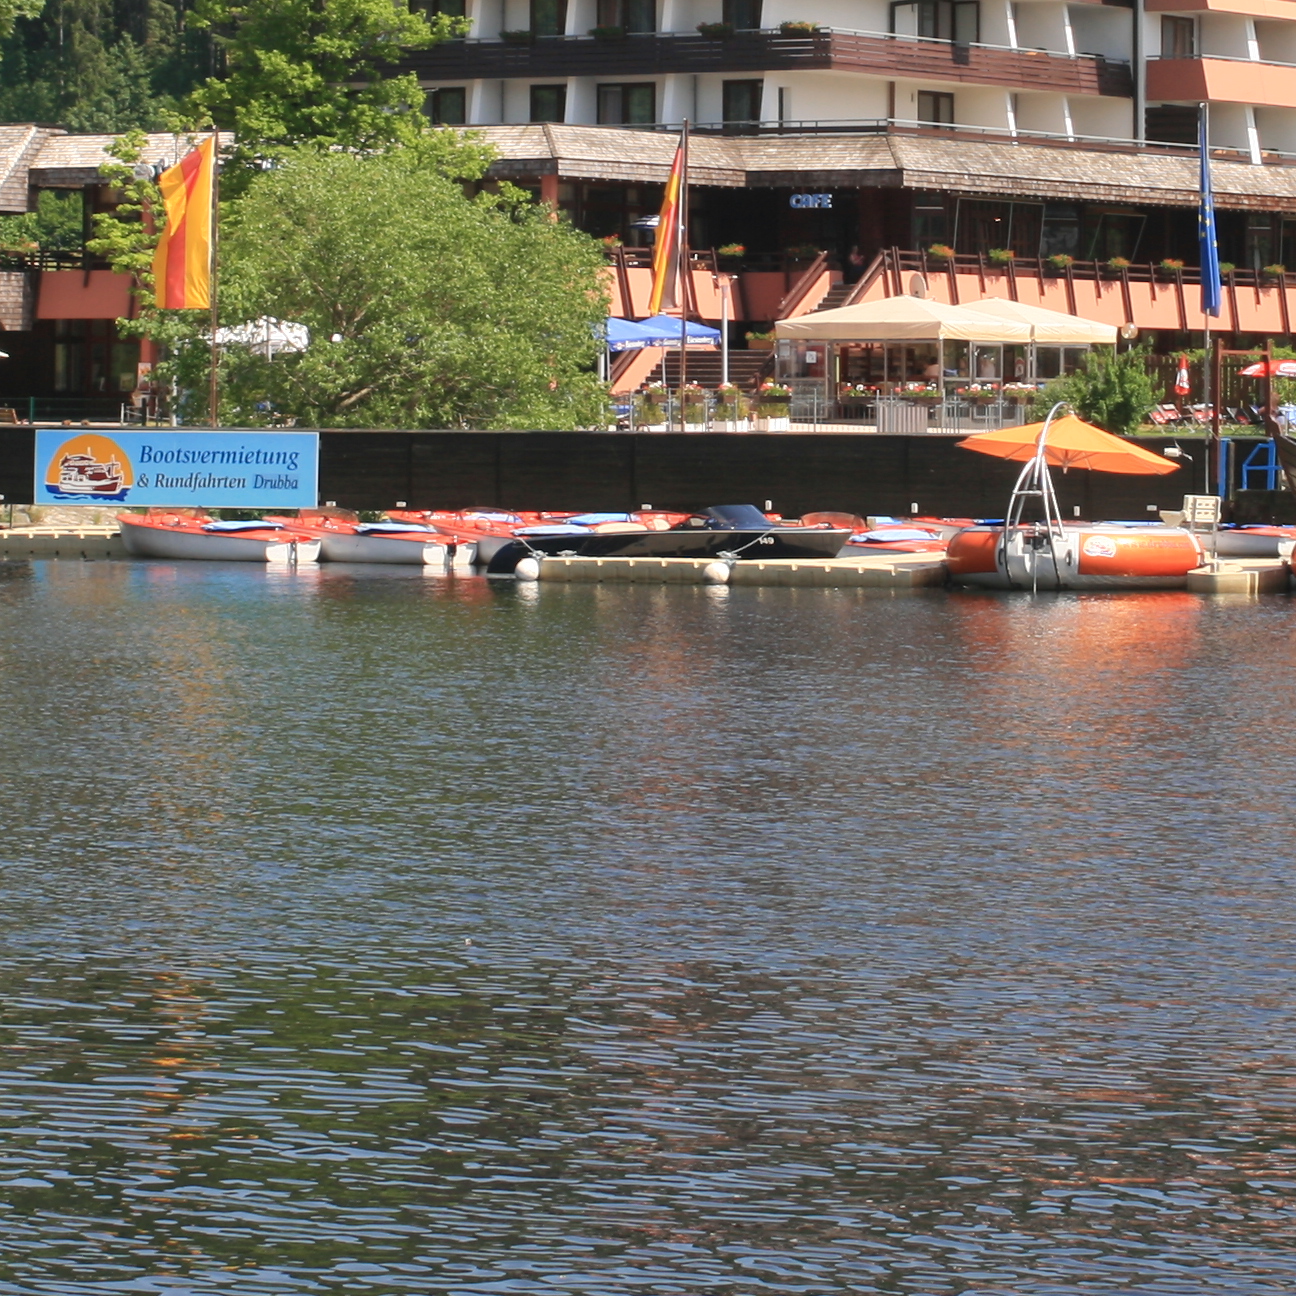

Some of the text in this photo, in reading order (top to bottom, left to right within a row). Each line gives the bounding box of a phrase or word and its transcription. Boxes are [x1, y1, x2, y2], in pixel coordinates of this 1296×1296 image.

[789, 193, 833, 209] CAFE
[139, 445, 300, 470] Bootsvermietung
[137, 472, 299, 492] & Rundfahrten Drubba
